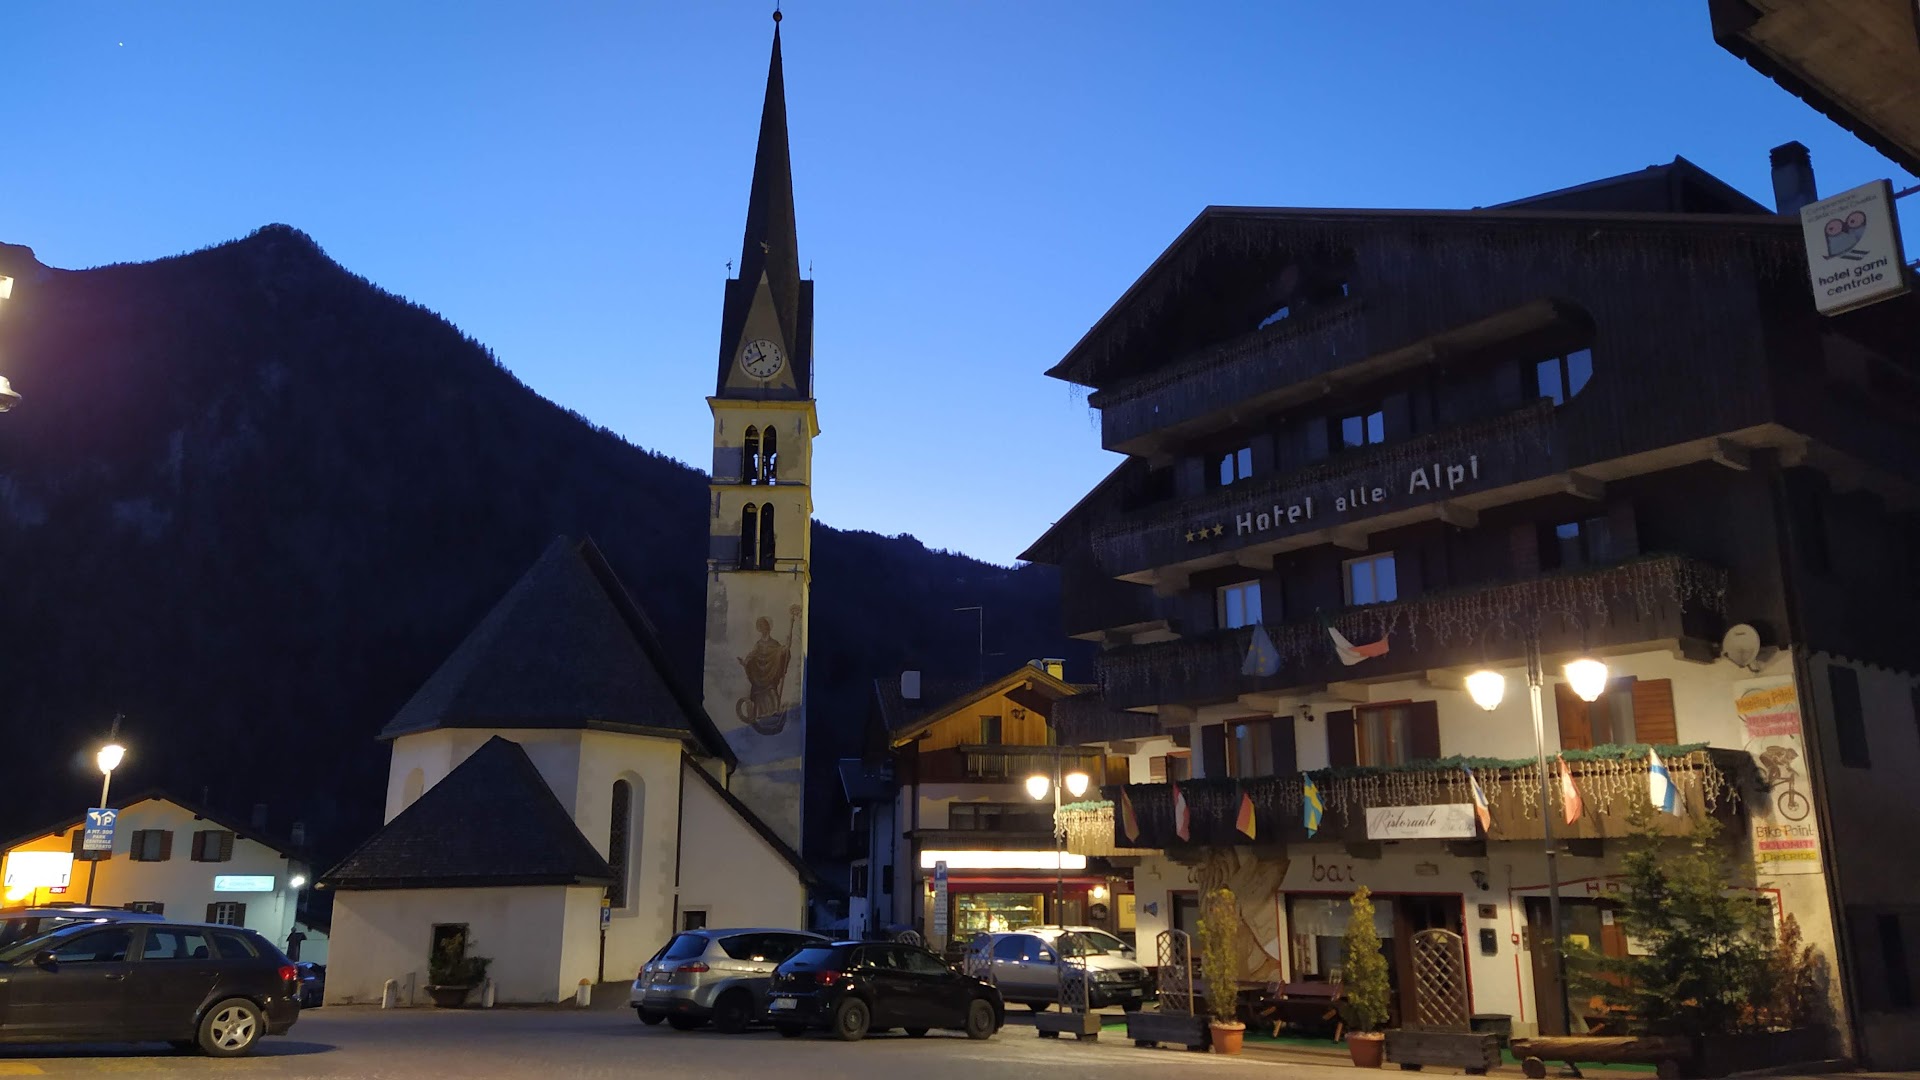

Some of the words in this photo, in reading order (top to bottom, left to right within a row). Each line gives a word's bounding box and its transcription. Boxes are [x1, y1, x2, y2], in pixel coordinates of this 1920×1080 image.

[1819, 268, 1850, 286] hotel
[1854, 256, 1888, 277] garni
[1827, 273, 1884, 296] centrale
[1236, 497, 1313, 536] Hotel
[1335, 486, 1385, 512] alle
[1409, 455, 1478, 495] Alpi
[103, 816, 112, 826] P
[1756, 826, 1782, 838] Bike
[1784, 824, 1815, 836] Point
[1311, 855, 1355, 882] bar
[603, 908, 610, 922] P
